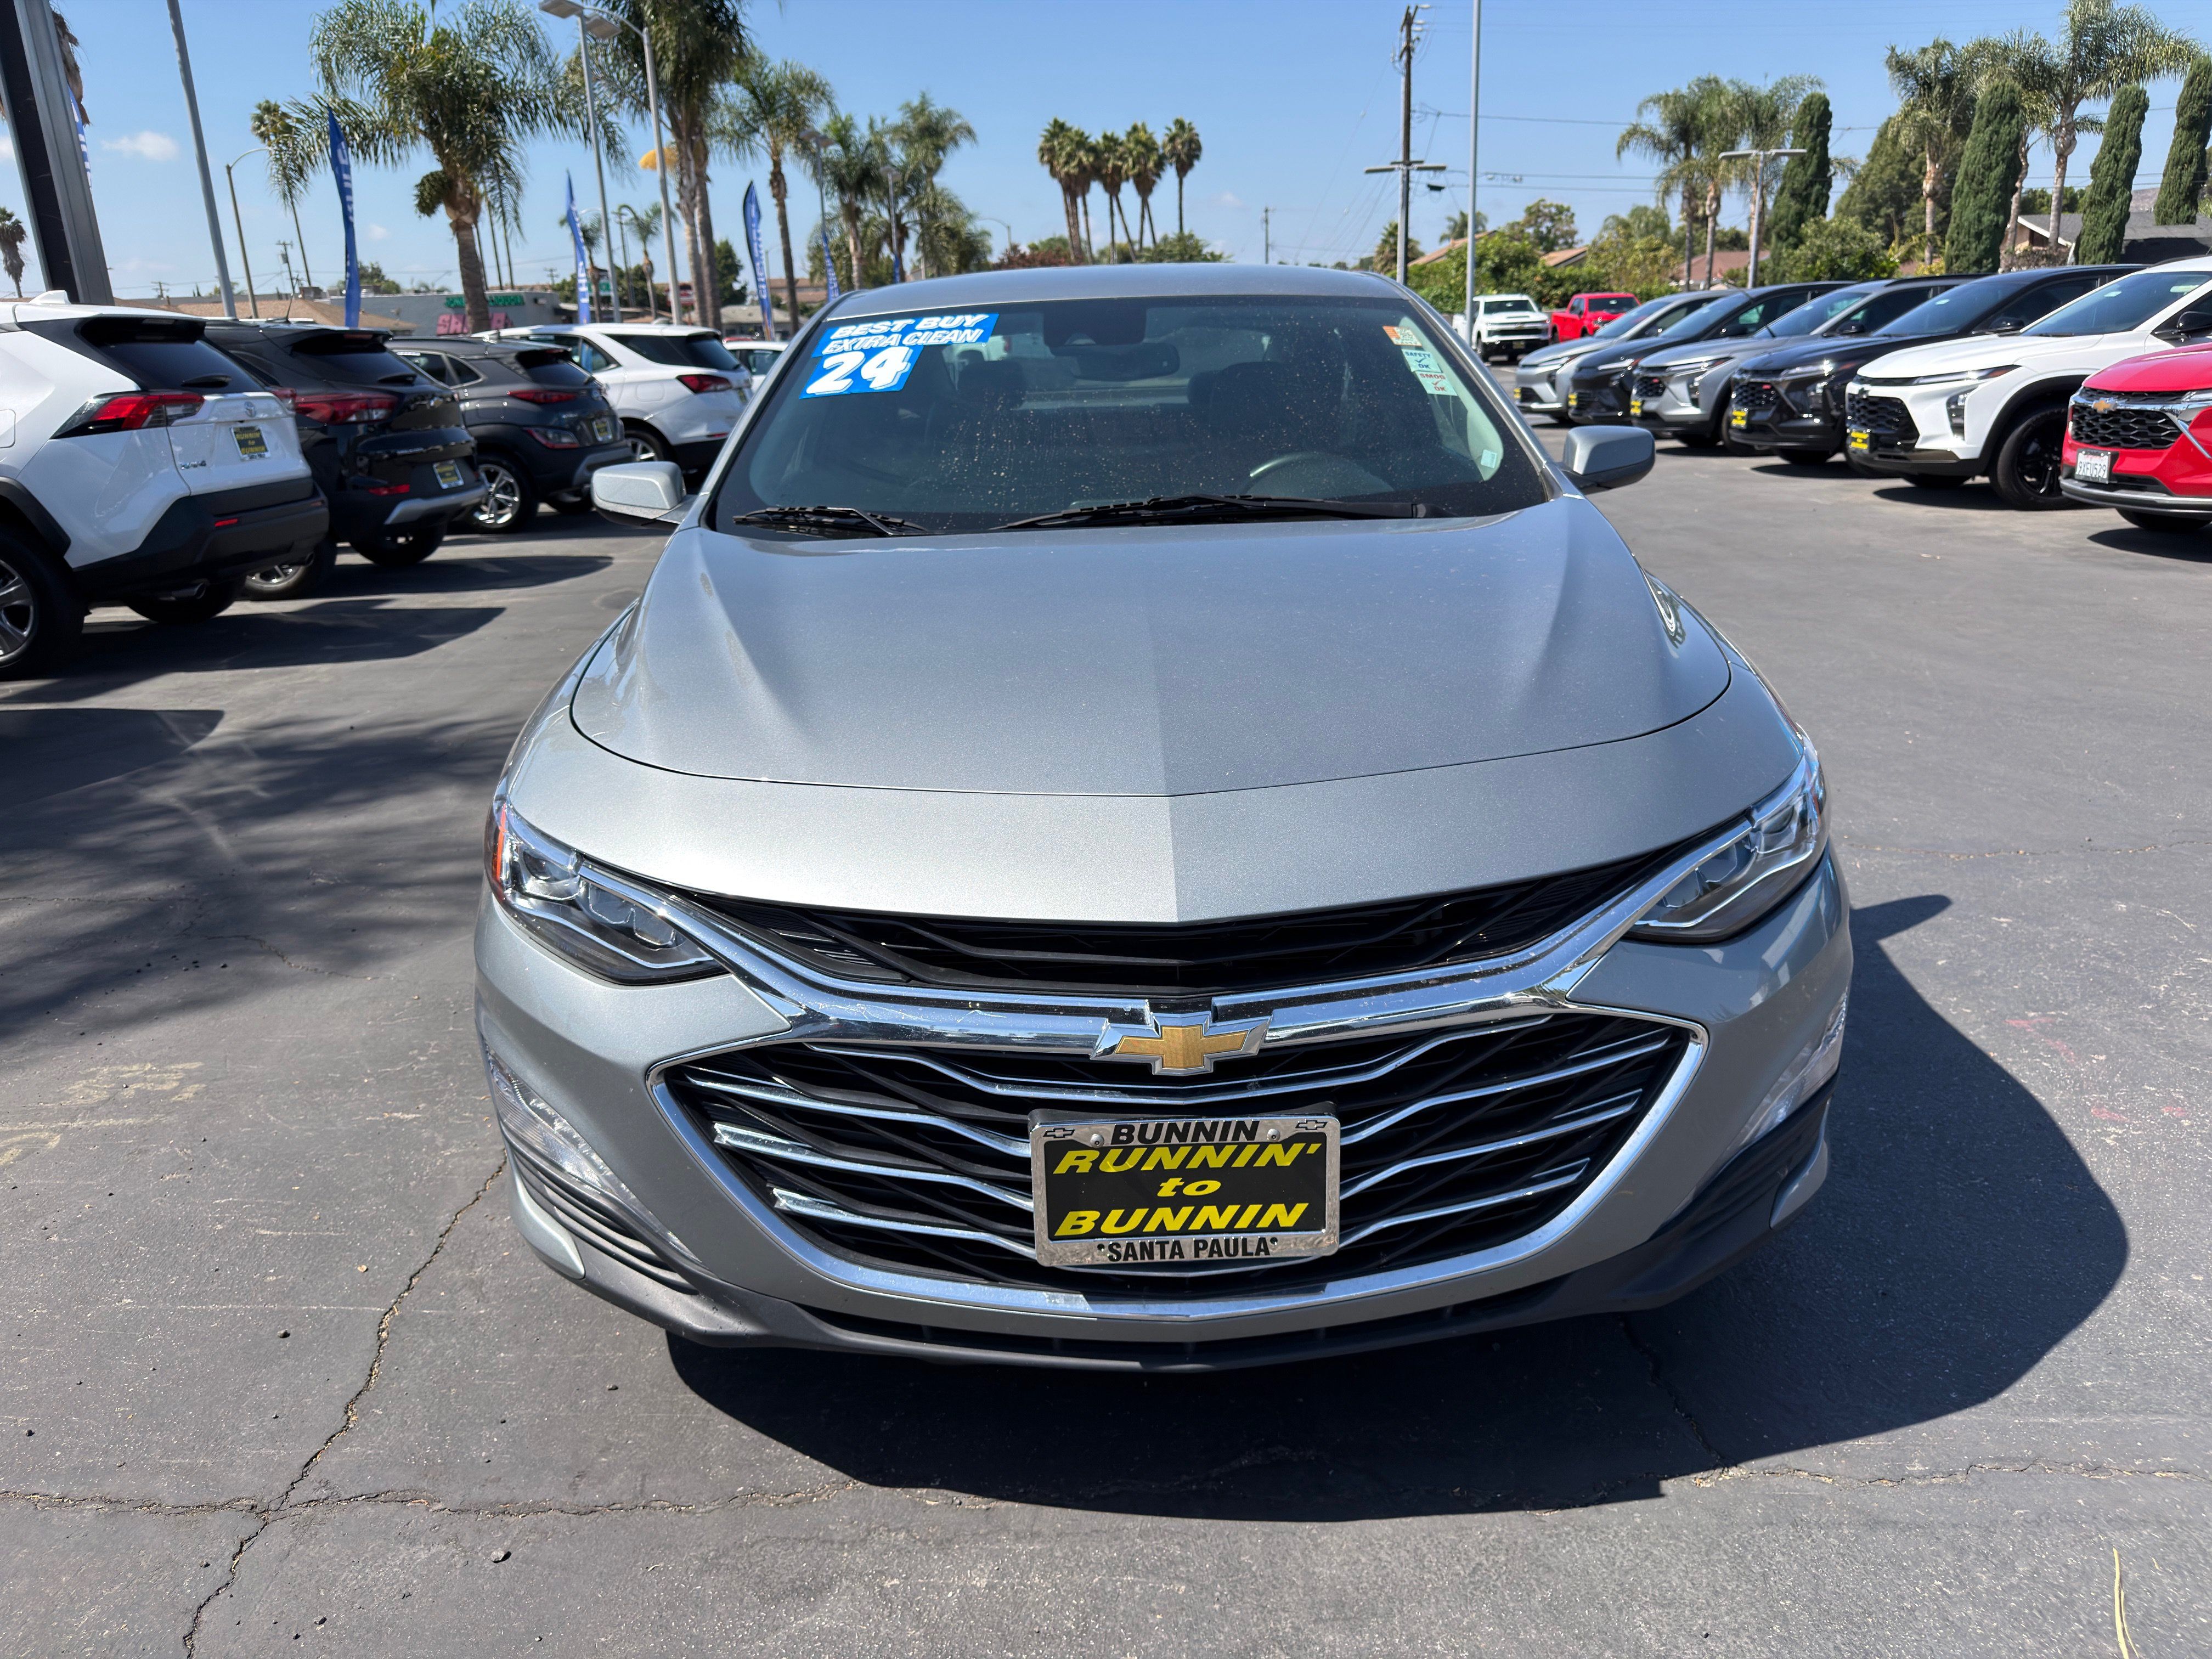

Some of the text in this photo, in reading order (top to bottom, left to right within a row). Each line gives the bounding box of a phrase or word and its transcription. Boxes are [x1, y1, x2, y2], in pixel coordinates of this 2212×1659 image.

[830, 314, 989, 339] BEST BUY
[822, 329, 984, 355] EXTRA CLEAN
[806, 346, 913, 396] 24
[1110, 1120, 1260, 1146] BUNNIN
[1053, 1142, 1322, 1174] RUNNIN'
[1157, 1177, 1221, 1197] to
[1054, 1203, 1309, 1237] BUNNIN
[1108, 1237, 1271, 1261] SANTA PAULA
